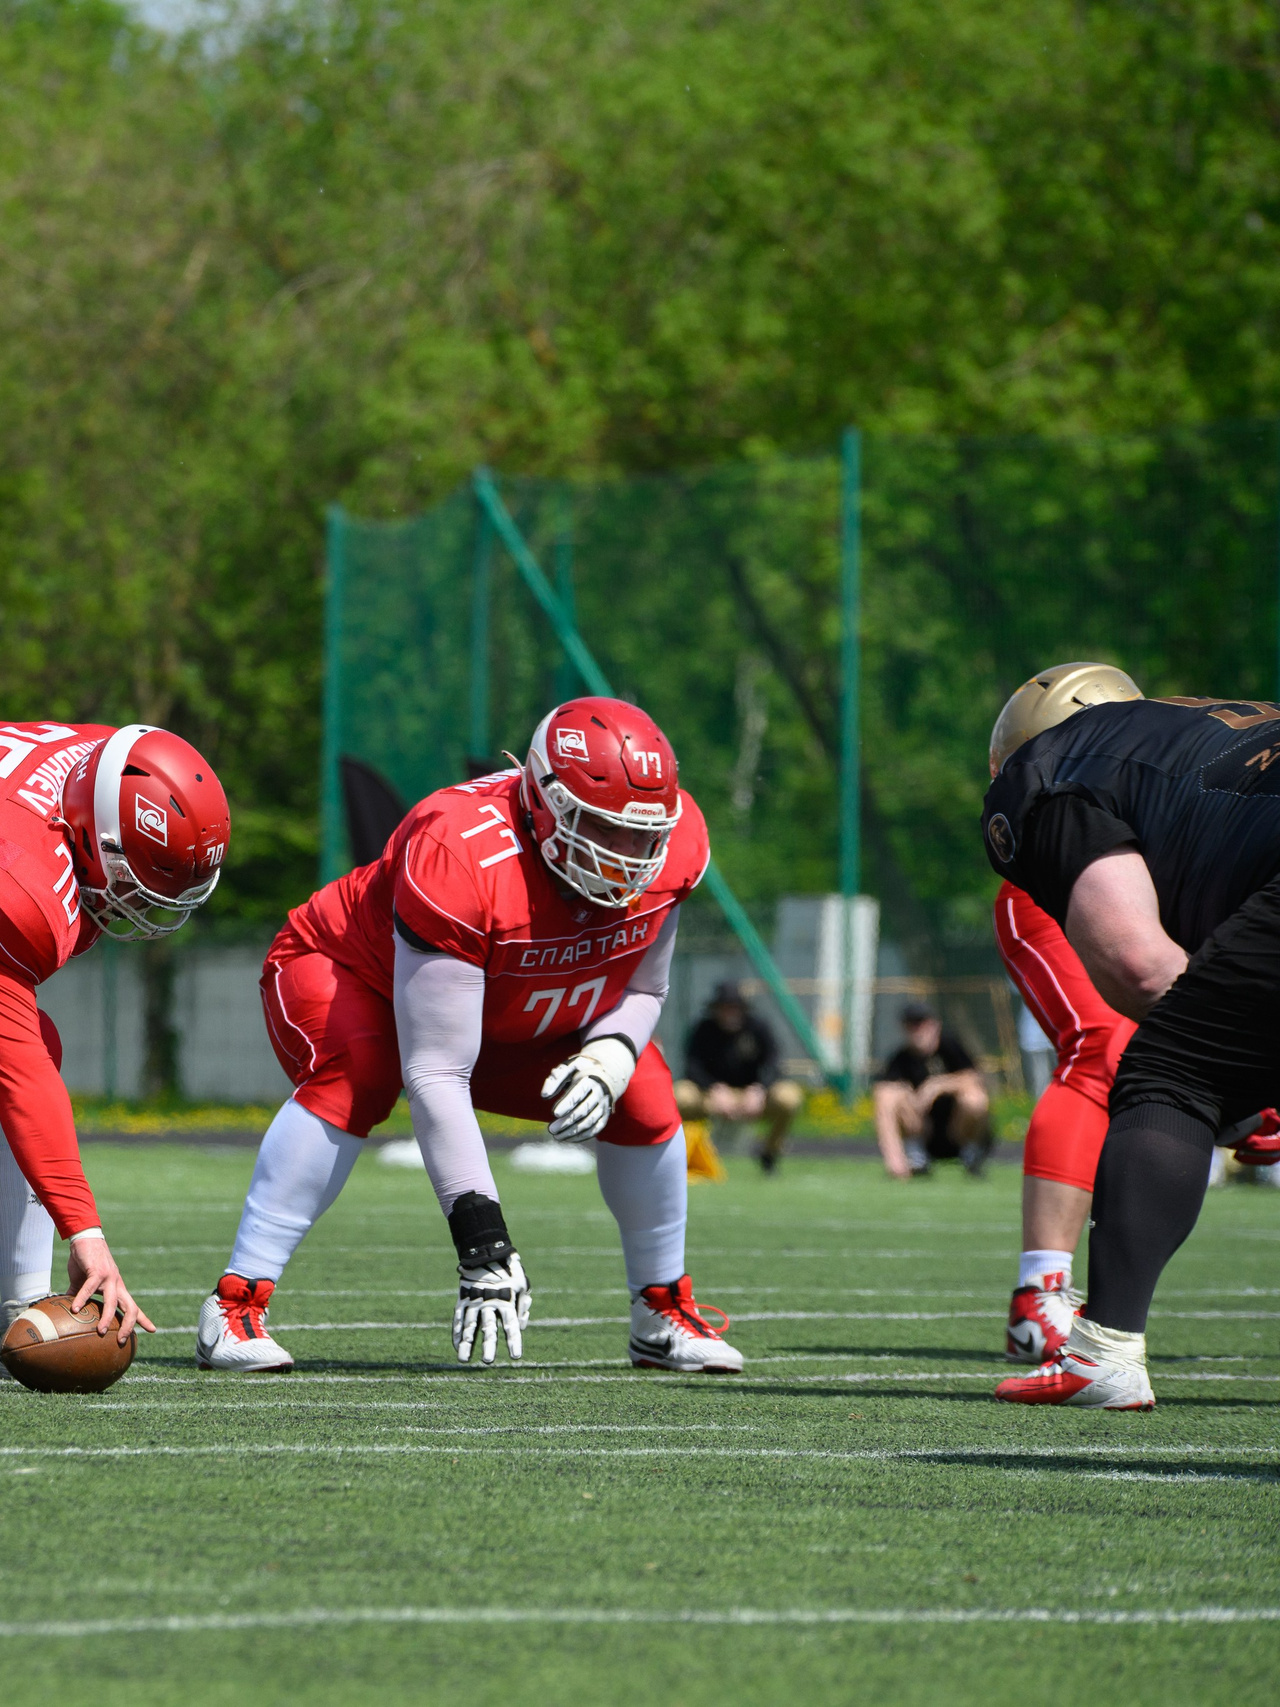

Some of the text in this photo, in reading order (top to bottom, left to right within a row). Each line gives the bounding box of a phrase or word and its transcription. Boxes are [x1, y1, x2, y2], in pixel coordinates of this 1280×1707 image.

[632, 751, 663, 779] 77
[206, 842, 225, 867] 70
[460, 803, 524, 869] 77
[520, 921, 649, 968] СПАРТАК
[523, 975, 608, 1039] 77
